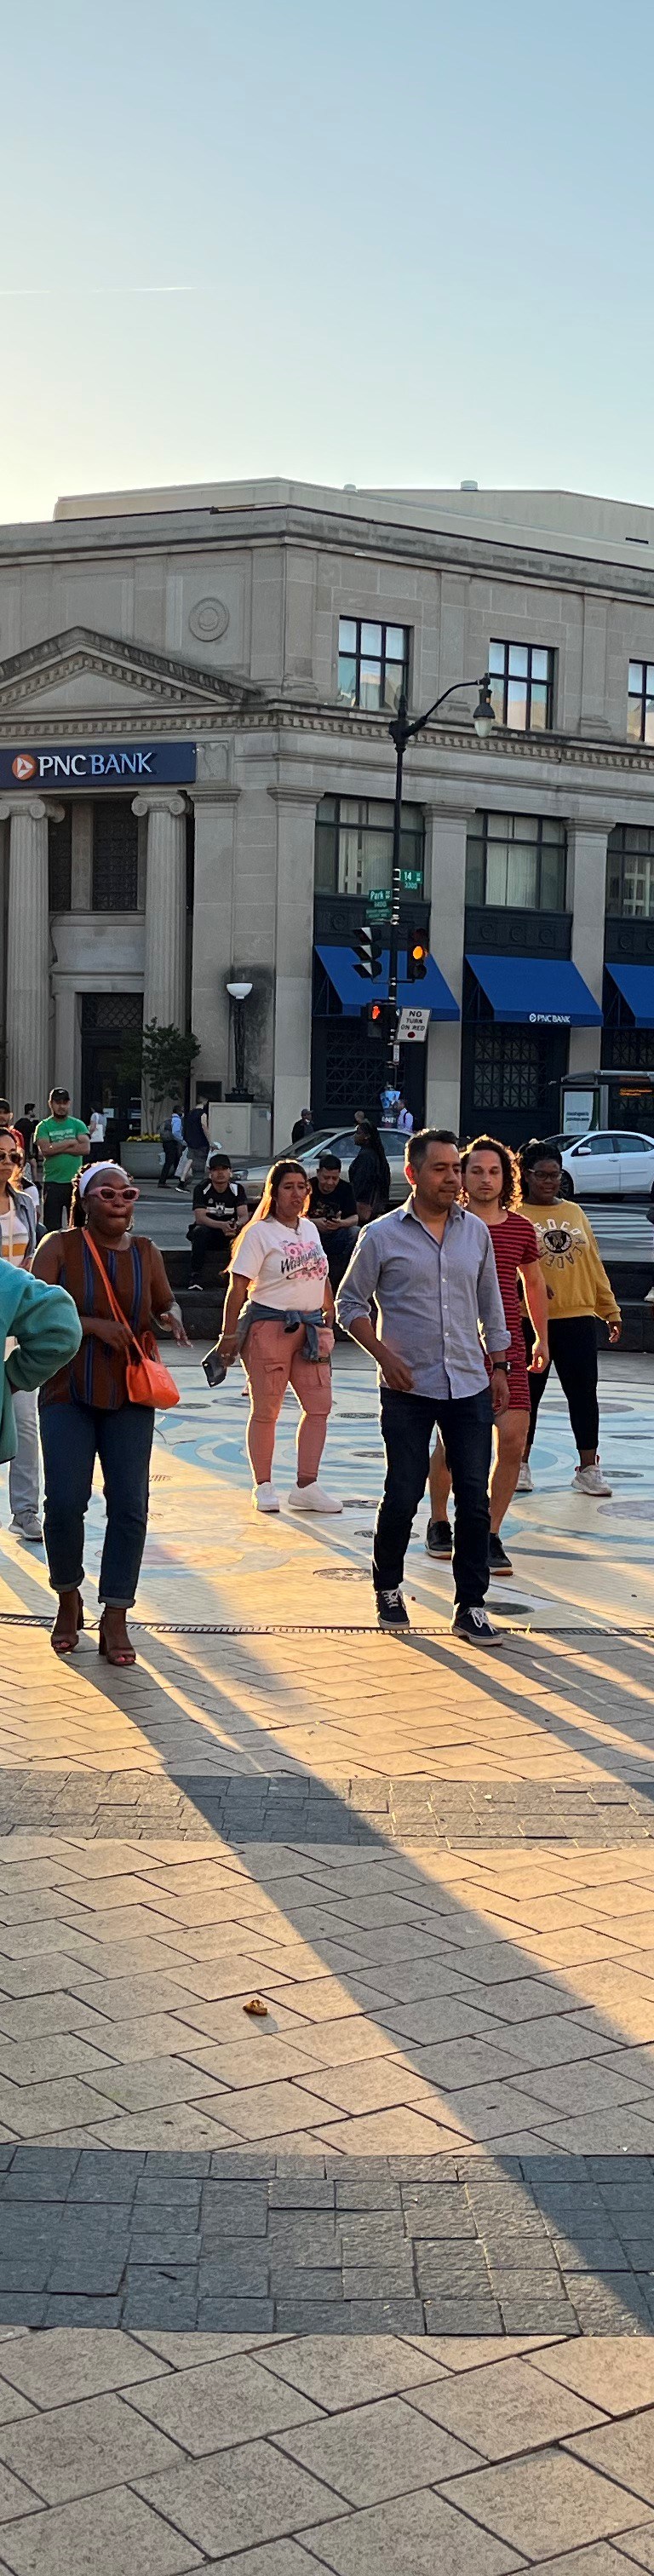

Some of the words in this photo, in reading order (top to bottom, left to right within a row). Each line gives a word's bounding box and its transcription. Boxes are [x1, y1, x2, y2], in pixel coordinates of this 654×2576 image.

[37, 754, 87, 777] PNC
[89, 752, 152, 775] BANK
[404, 871, 412, 882] 14
[370, 890, 384, 900] Park
[552, 1015, 571, 1024] BANK
